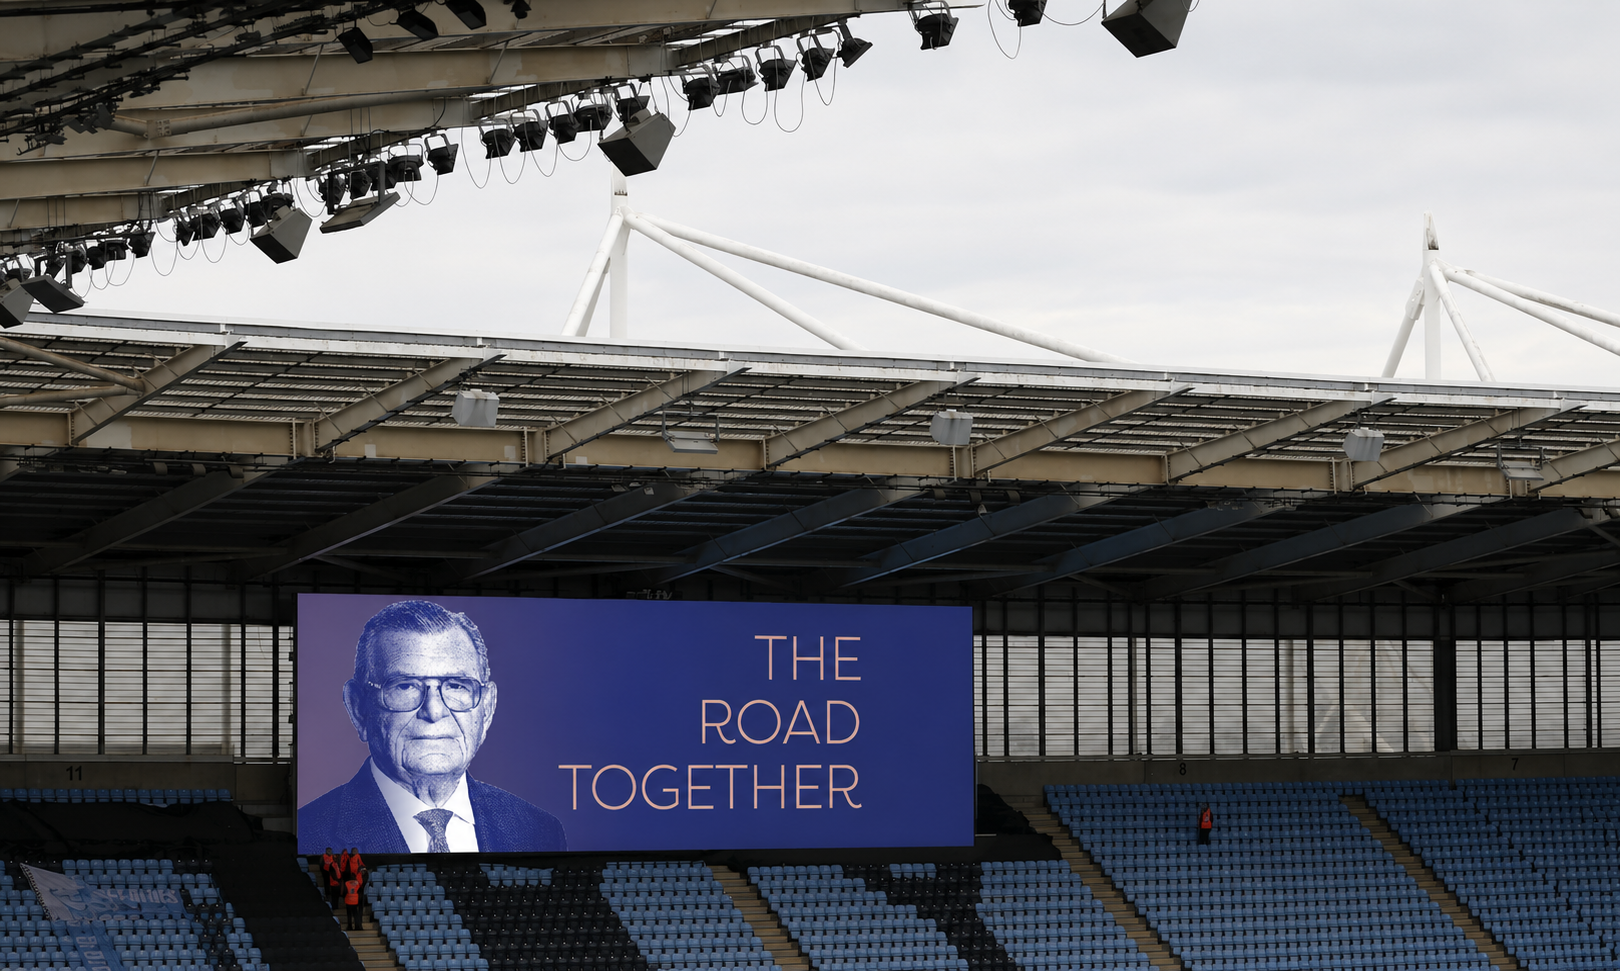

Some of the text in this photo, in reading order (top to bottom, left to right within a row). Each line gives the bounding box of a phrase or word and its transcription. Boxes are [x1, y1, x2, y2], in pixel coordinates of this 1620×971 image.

[754, 635, 861, 681] THE
[701, 699, 860, 745] ROAD
[66, 765, 83, 781] 11
[1179, 762, 1187, 776] 8
[1511, 757, 1519, 771] 7
[558, 764, 862, 810] TOGETHER
